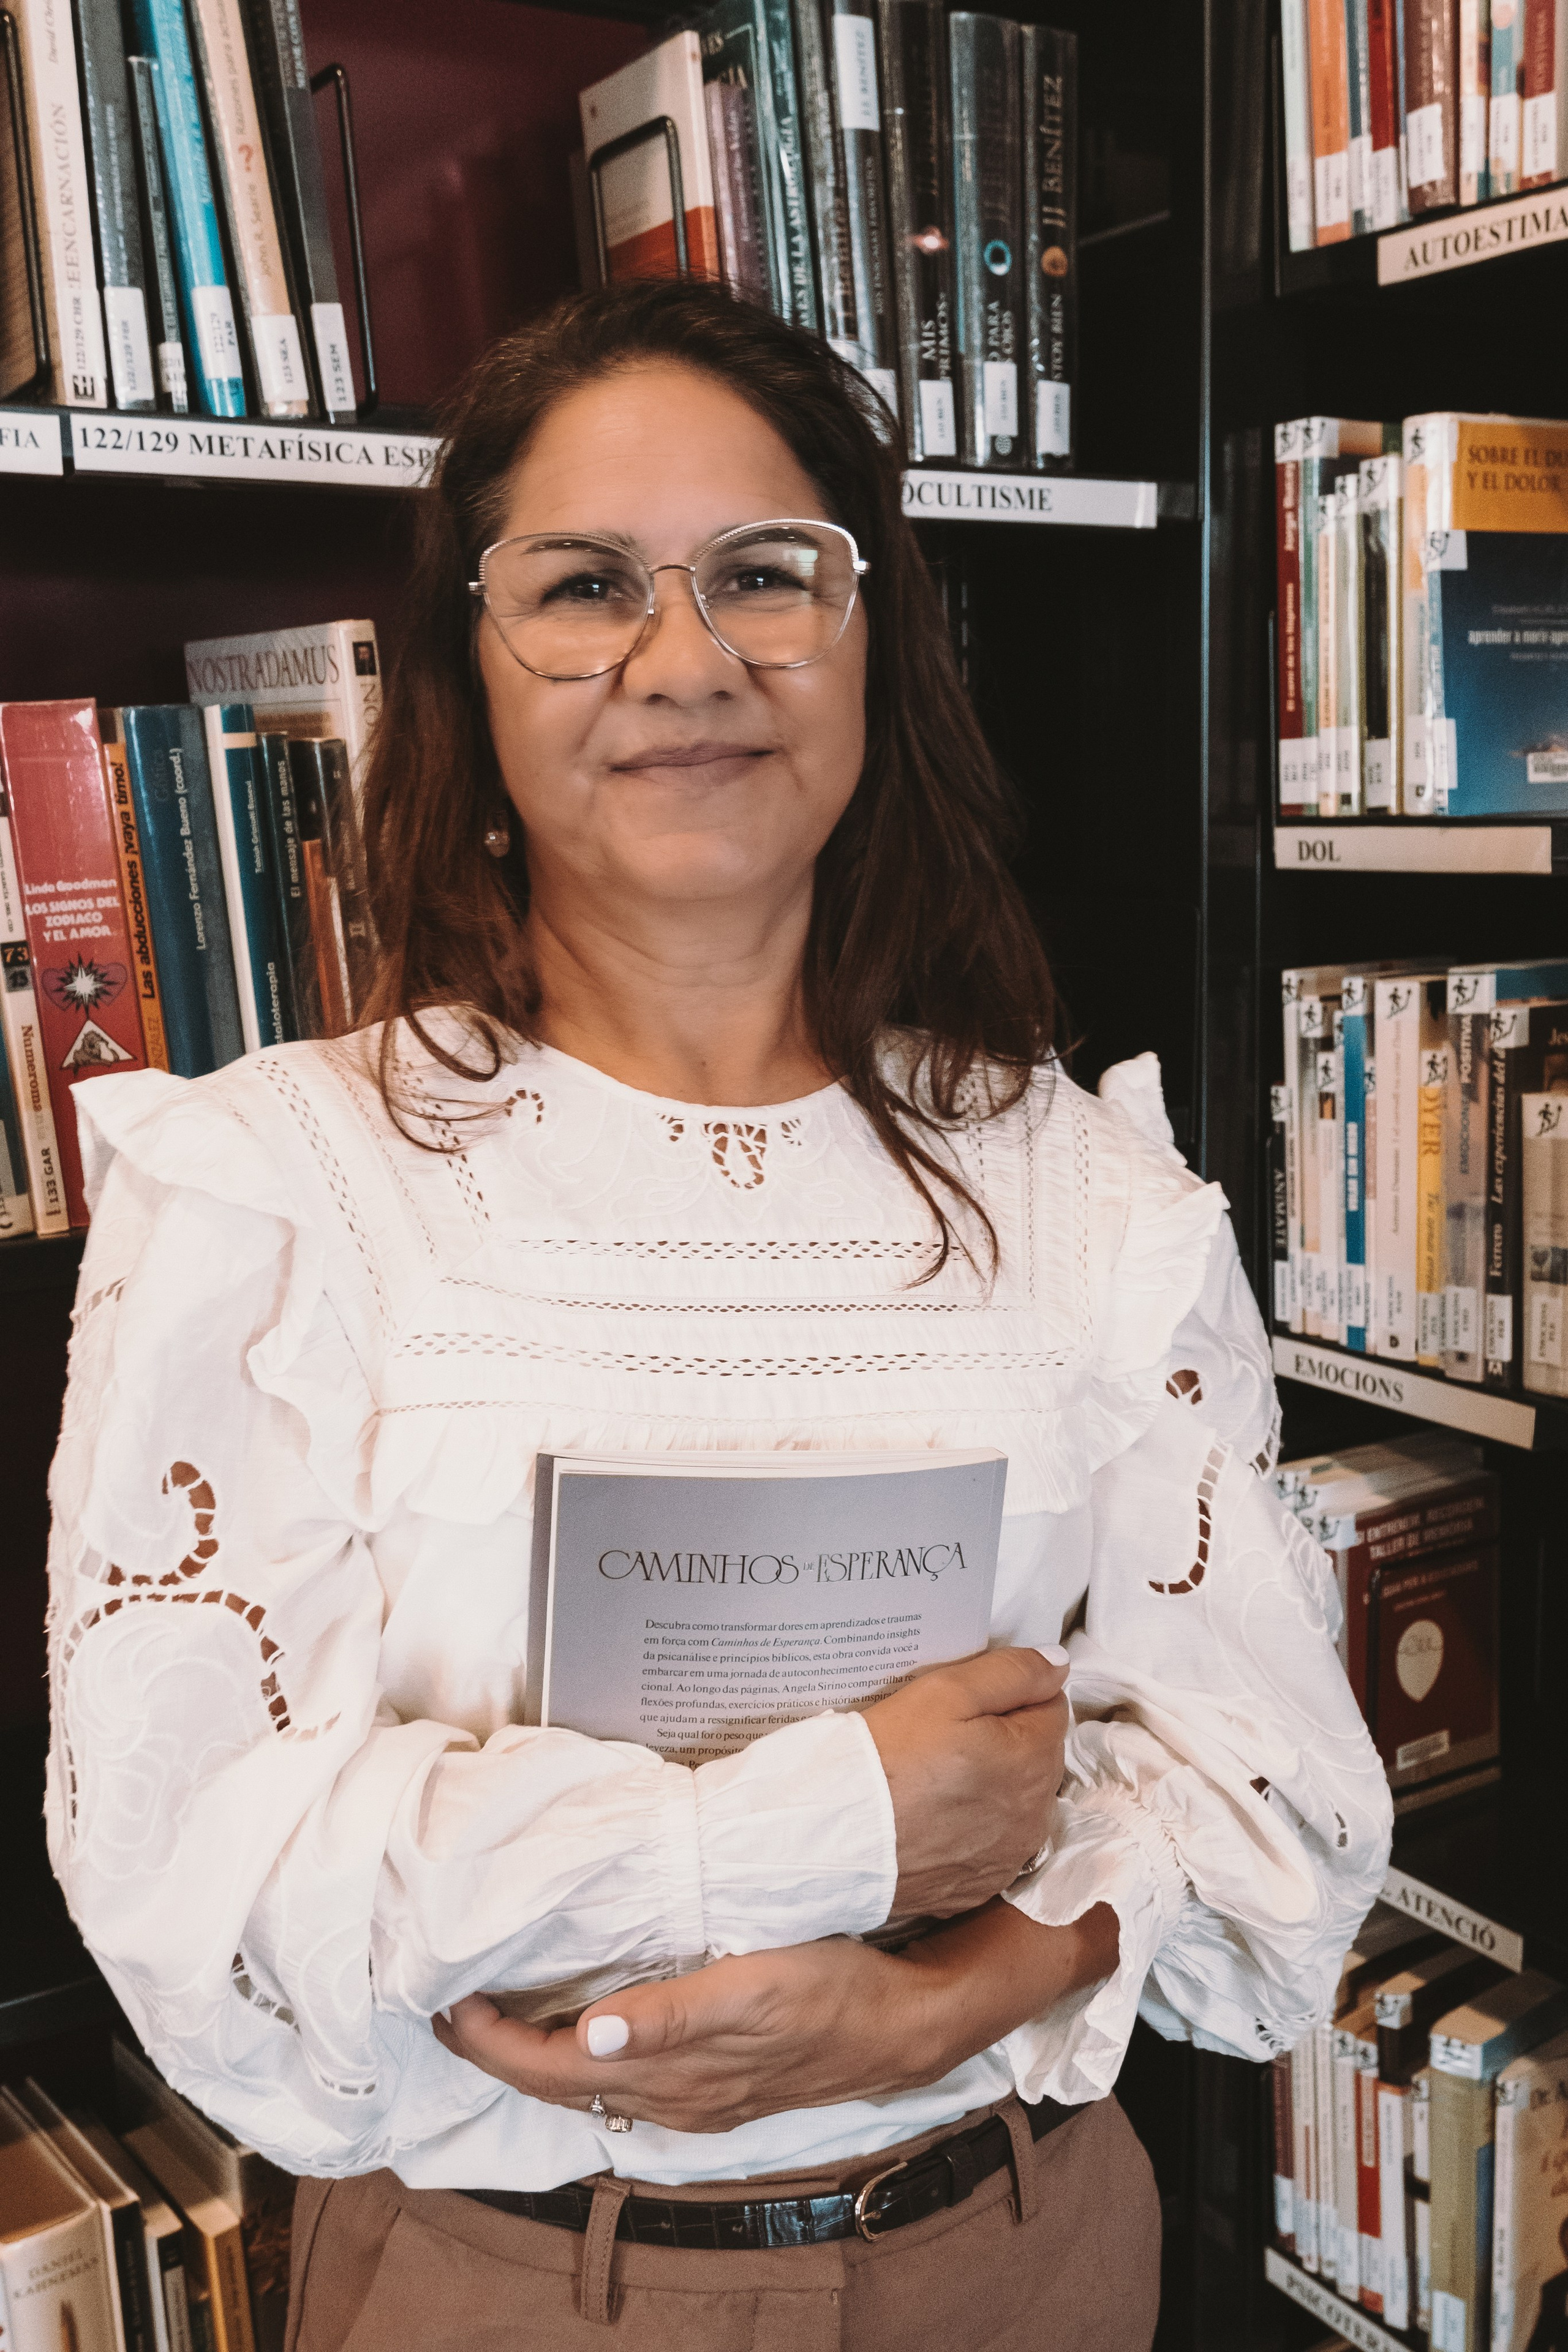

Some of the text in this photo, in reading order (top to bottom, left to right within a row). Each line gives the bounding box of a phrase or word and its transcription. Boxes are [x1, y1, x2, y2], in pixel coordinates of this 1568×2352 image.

[1039, 74, 1066, 228] JJ BENÍTEZ
[51, 104, 81, 288] EENCARNACIÓN
[1404, 206, 1568, 271] AUTOESTIMA
[987, 300, 1001, 347] PARA
[1050, 293, 1064, 334] BIEN
[921, 320, 937, 361] MIS
[328, 343, 342, 373] SEM
[80, 427, 179, 454] 122/129
[189, 432, 374, 466] METAFÍSICA
[1467, 471, 1478, 490] Y
[186, 644, 340, 694] NOSTRADAMUS
[277, 760, 301, 898] El mensaje de las manos
[168, 747, 207, 950] Lorenzo Fernández Bueno (coord.)
[1297, 839, 1341, 863] DOL
[24, 878, 117, 895] Linda Goodman
[111, 761, 156, 1000] Las abducciones ¡vaya timo!
[25, 895, 121, 915] LOS SIGNOS DEL
[45, 911, 104, 928] ZODIACO
[42, 924, 113, 942] Y EL AMOR
[4, 946, 29, 963] 73
[1490, 1061, 1506, 1085] del
[1490, 1087, 1507, 1175] experiencias
[40, 1147, 59, 1204] 133 GAR
[1490, 1177, 1504, 1204] Las
[1490, 1223, 1504, 1278] Ferrero
[1294, 1354, 1404, 1404] EMOCIONS
[598, 1542, 968, 1584] CAMINHOS DE ESPERANÇA
[645, 1619, 690, 1630] Descubra
[721, 1623, 777, 1631] transformar
[820, 1617, 880, 1631] aprendizados
[888, 1613, 922, 1624] traumas
[662, 1636, 686, 1646] força
[711, 1637, 758, 1647] Caminhos
[760, 1638, 771, 1647] de
[772, 1637, 823, 1648] Esperança.
[824, 1632, 886, 1645] Combinando
[887, 1628, 921, 1640] insights
[643, 1651, 655, 1660] da
[657, 1651, 711, 1663] psicanálise
[720, 1653, 770, 1664] princípios
[772, 1653, 812, 1663] bíblicos,
[832, 1651, 853, 1660] obra
[855, 1646, 891, 1658] convida
[893, 1643, 913, 1653] você
[641, 1673, 916, 1695] cional. Ao longo das páginas, Angela Sirino compartilha re-
[642, 1667, 688, 1678] embarcar
[729, 1669, 767, 1680] jornada
[769, 1669, 780, 1678] de
[782, 1664, 868, 1678] autoconhecimento
[875, 1662, 895, 1671] cura
[895, 1659, 918, 1668] emo-
[641, 1697, 673, 1707] flexões
[675, 1699, 727, 1709] profundas,
[728, 1699, 775, 1709] exercícios
[776, 1699, 813, 1710] práticos
[821, 1695, 860, 1706] histórias
[639, 1714, 658, 1723] que
[660, 1714, 697, 1724] ajudam
[707, 1715, 767, 1725] ressignificar
[767, 1714, 802, 1724] feridas
[657, 1728, 676, 1738] Seja
[677, 1730, 699, 1740] qual
[701, 1730, 715, 1739] for
[723, 1732, 745, 1741] peso
[1396, 1886, 1496, 1951] ATENCIÓ
